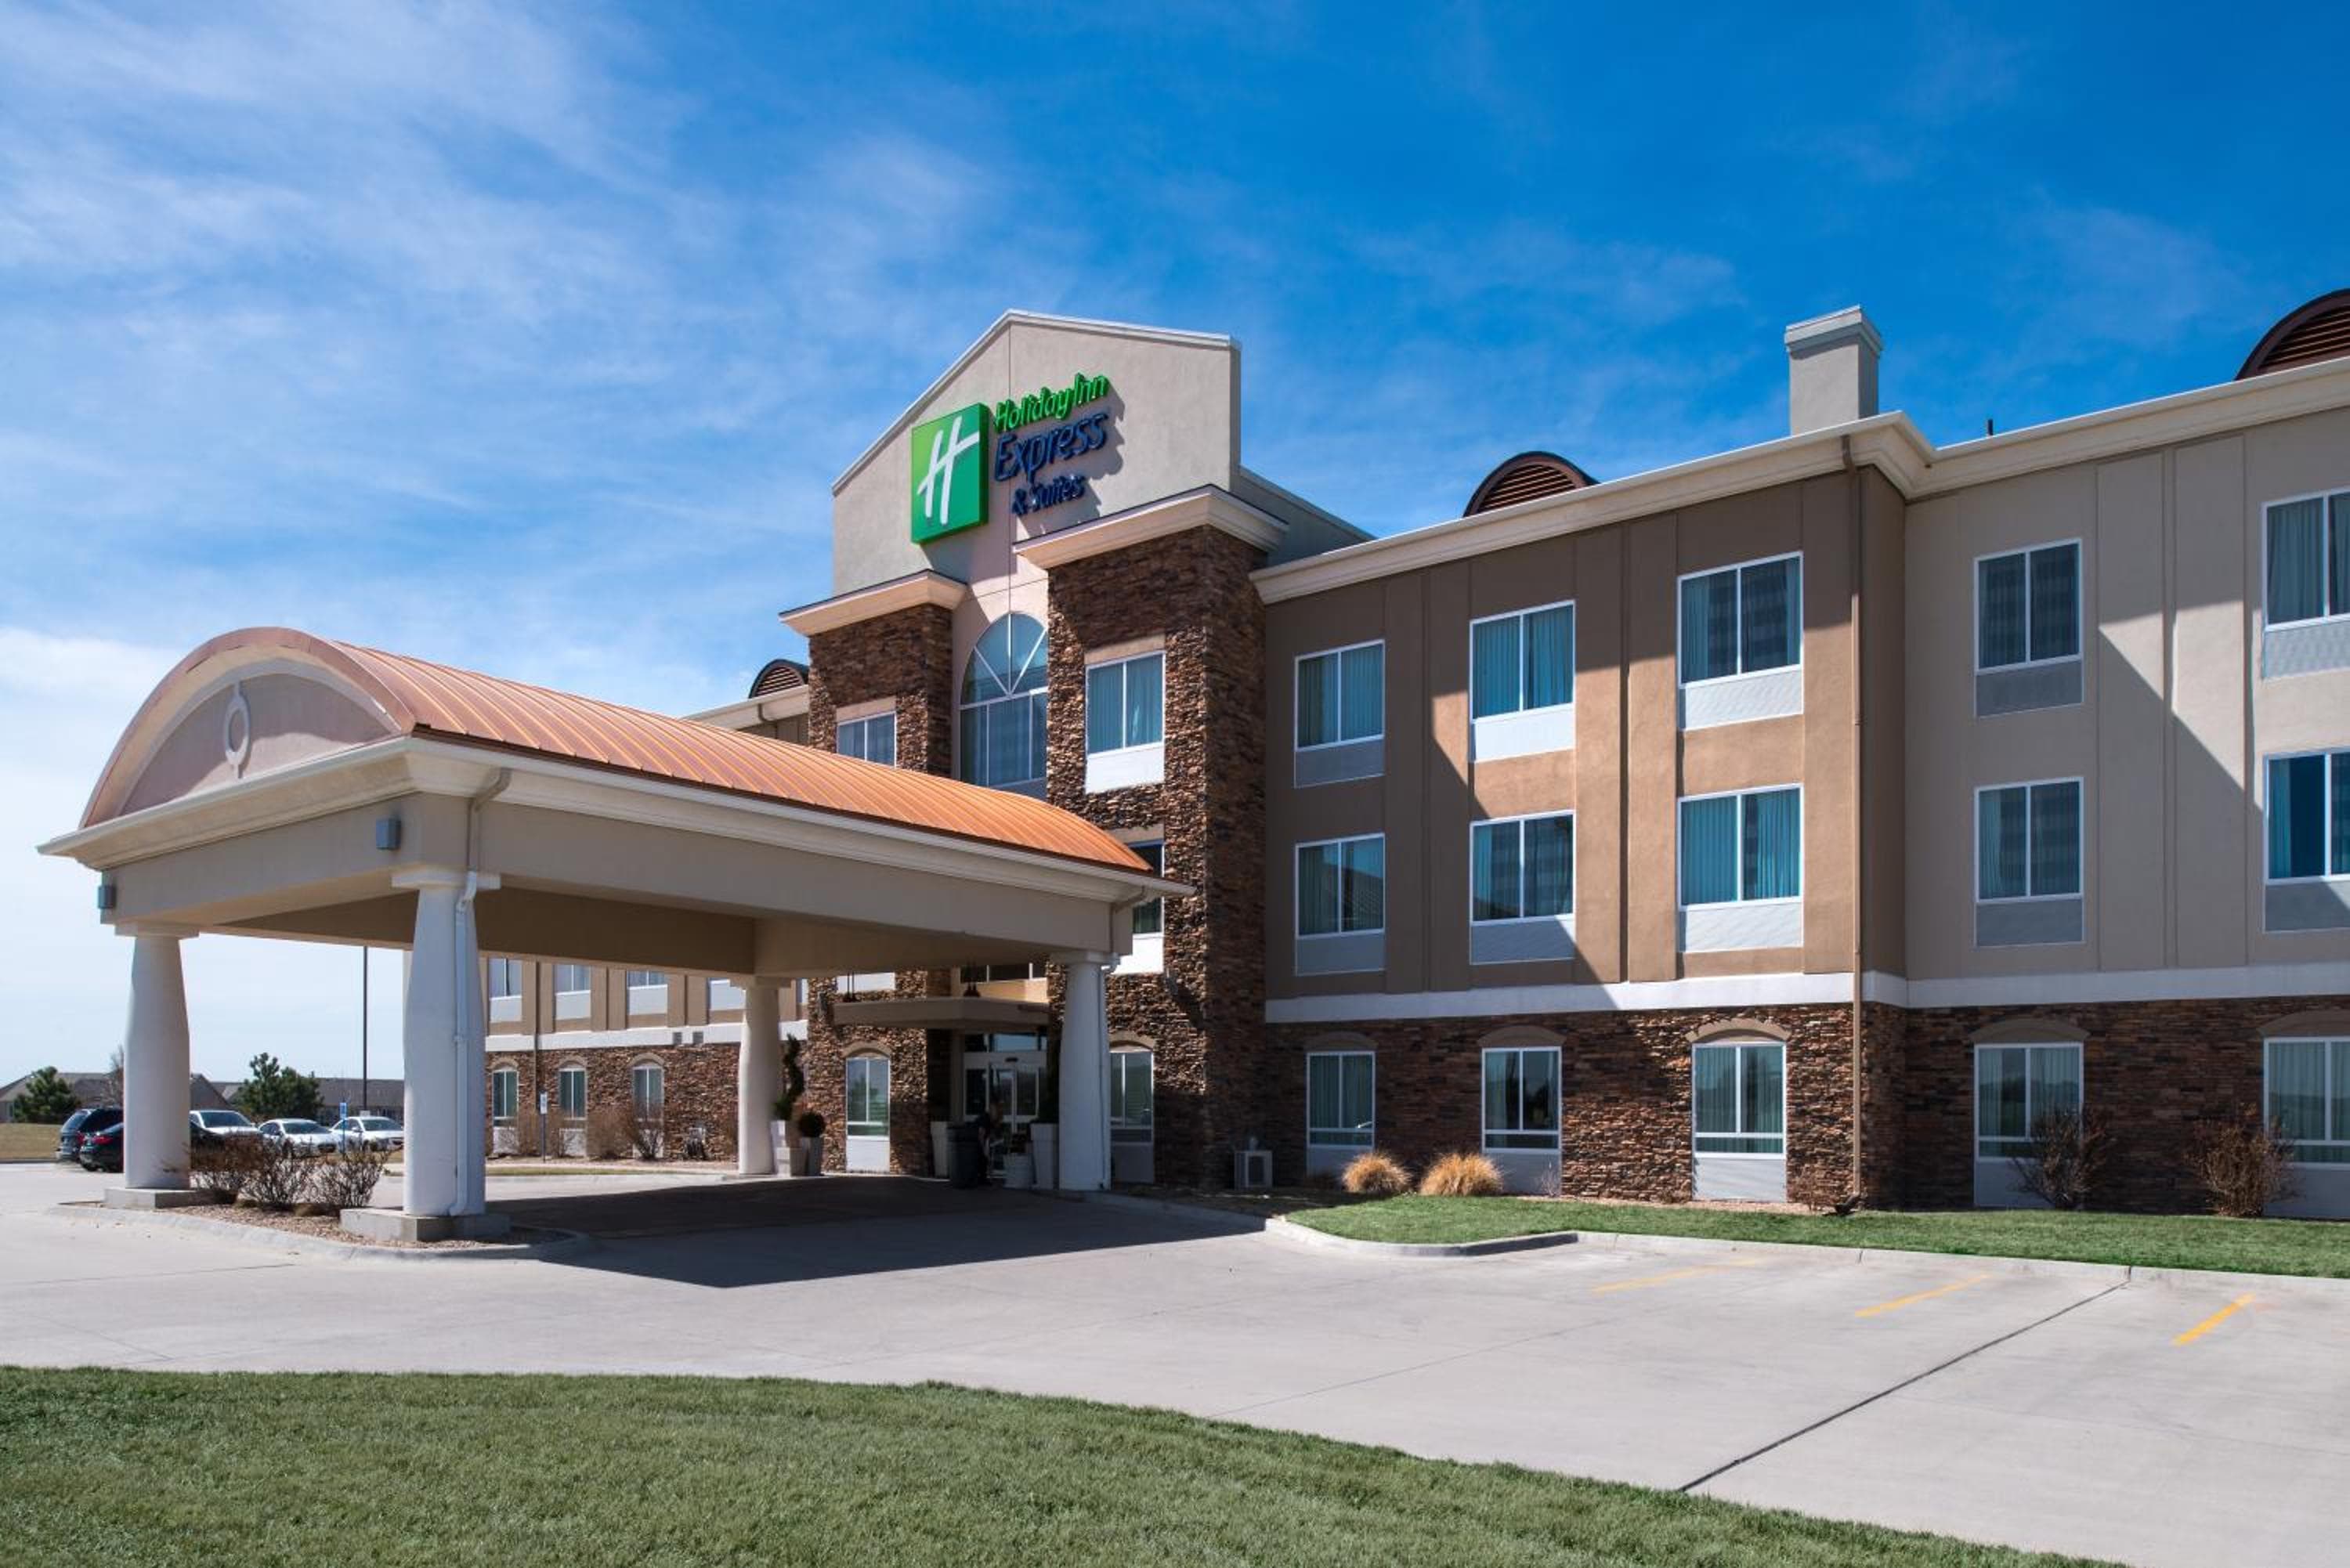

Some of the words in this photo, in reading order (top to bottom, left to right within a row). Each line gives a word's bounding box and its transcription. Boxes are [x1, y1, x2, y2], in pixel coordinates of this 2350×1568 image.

[995, 386, 1073, 432] Holiday
[1074, 372, 1110, 406] Inn
[994, 412, 1108, 484] Express
[1011, 487, 1029, 516] &
[1031, 474, 1086, 511] Suites
